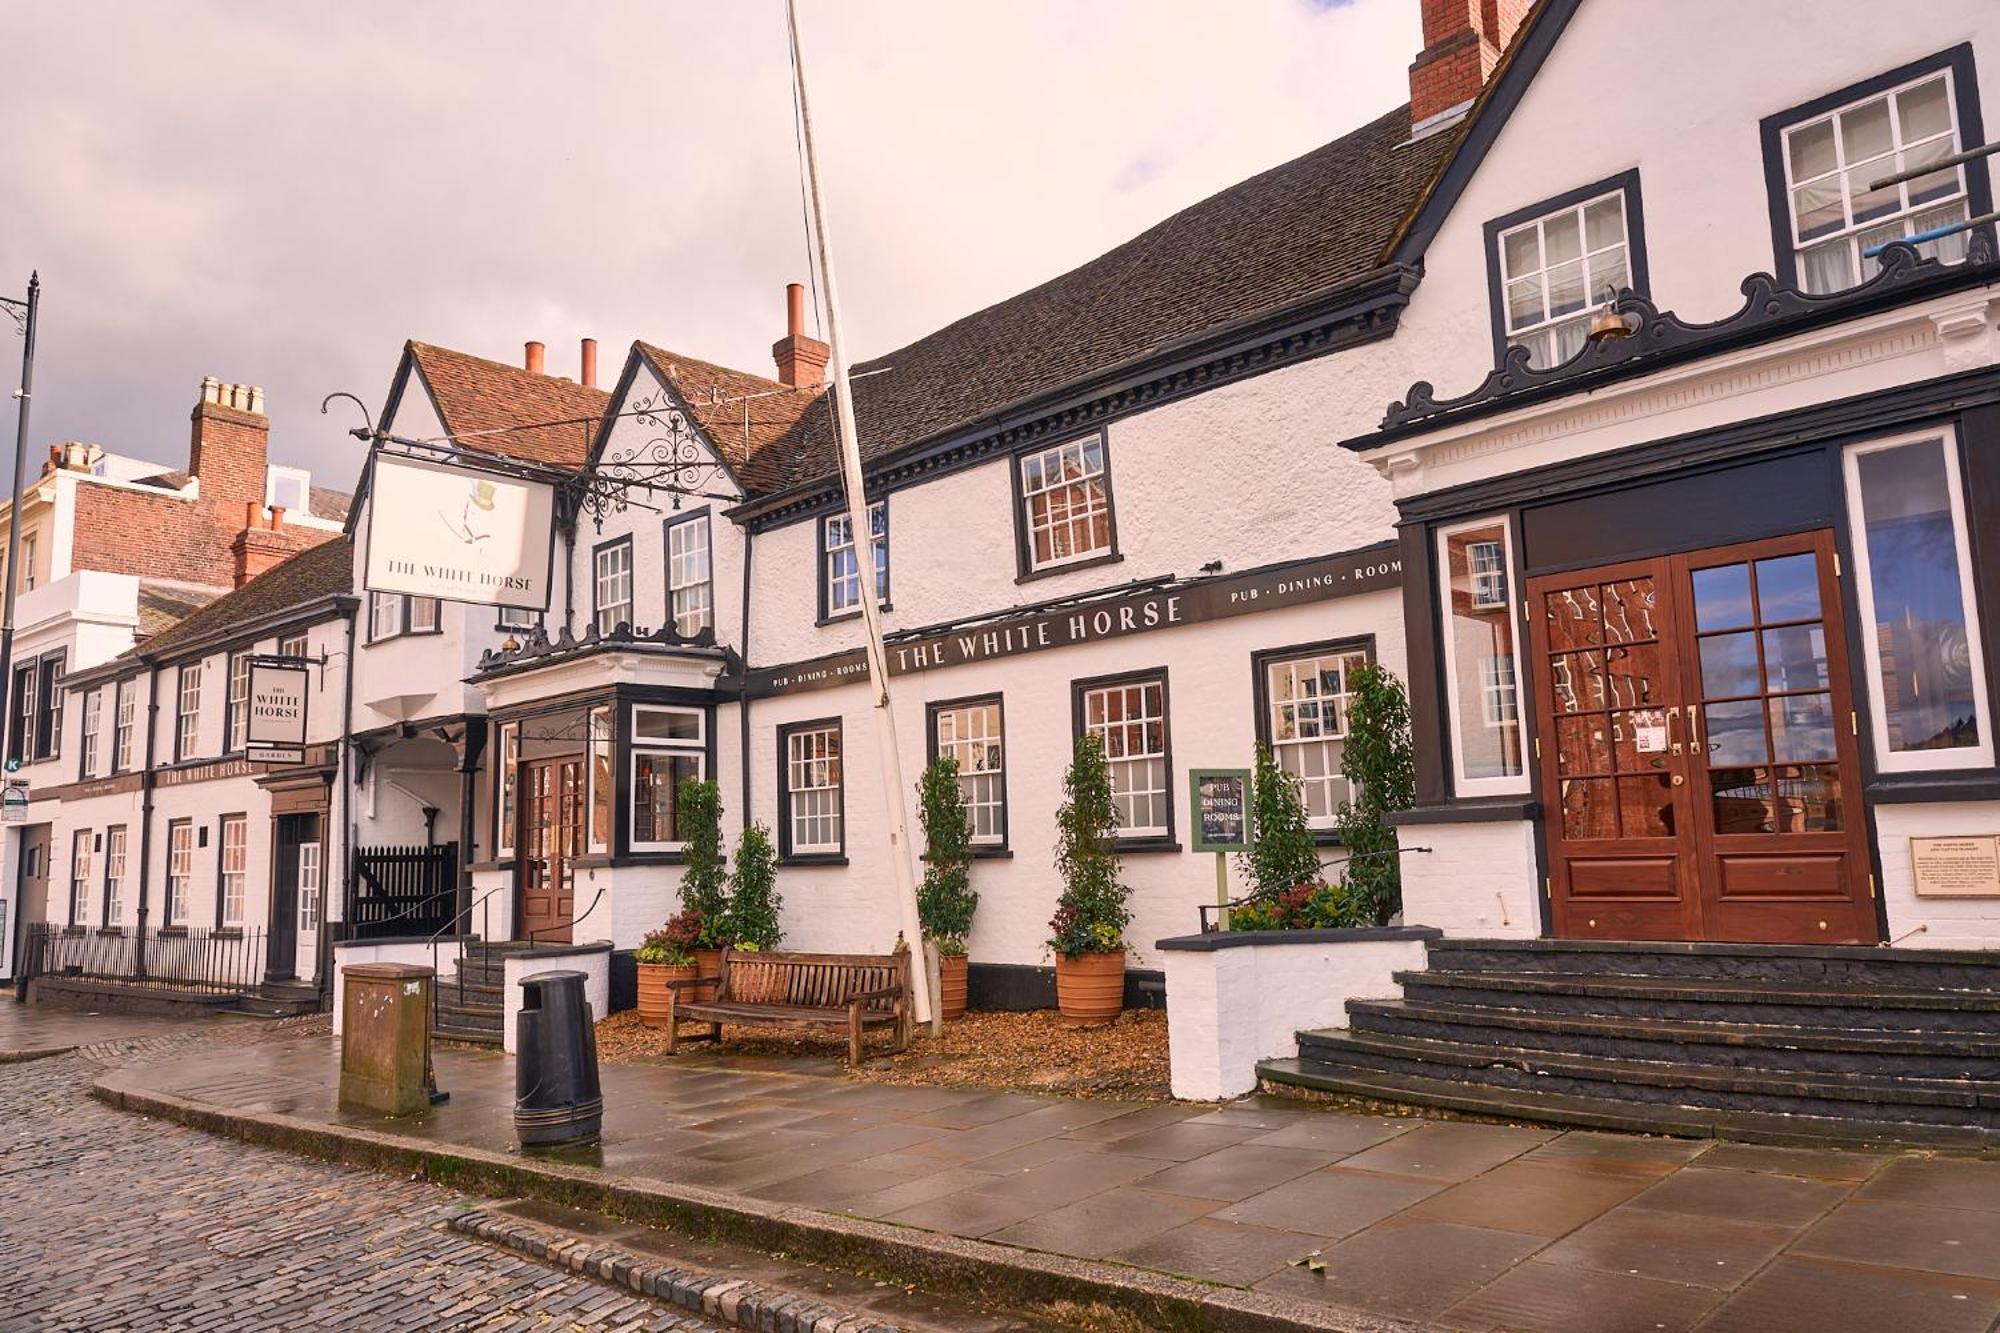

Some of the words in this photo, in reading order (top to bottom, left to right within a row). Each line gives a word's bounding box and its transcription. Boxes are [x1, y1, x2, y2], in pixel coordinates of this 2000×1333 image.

[388, 560, 415, 575] THE
[424, 565, 472, 583] WHITE
[480, 573, 533, 591] HORSE
[1231, 588, 1259, 603] PUB
[1278, 574, 1334, 595] DINING
[896, 641, 945, 671] THE
[958, 622, 1051, 659] WHITE
[1068, 596, 1182, 640] HORSE
[773, 677, 789, 688] PUB
[798, 670, 828, 683] DINING
[836, 662, 868, 675] ROOMS
[255, 706, 300, 718] HORSE
[256, 694, 300, 706] WHITE
[166, 770, 183, 785] THE
[186, 765, 215, 782] WHITE
[219, 761, 254, 777] HORSE
[1203, 797, 1238, 806] DINING
[1203, 812, 1239, 822] ROOMS
